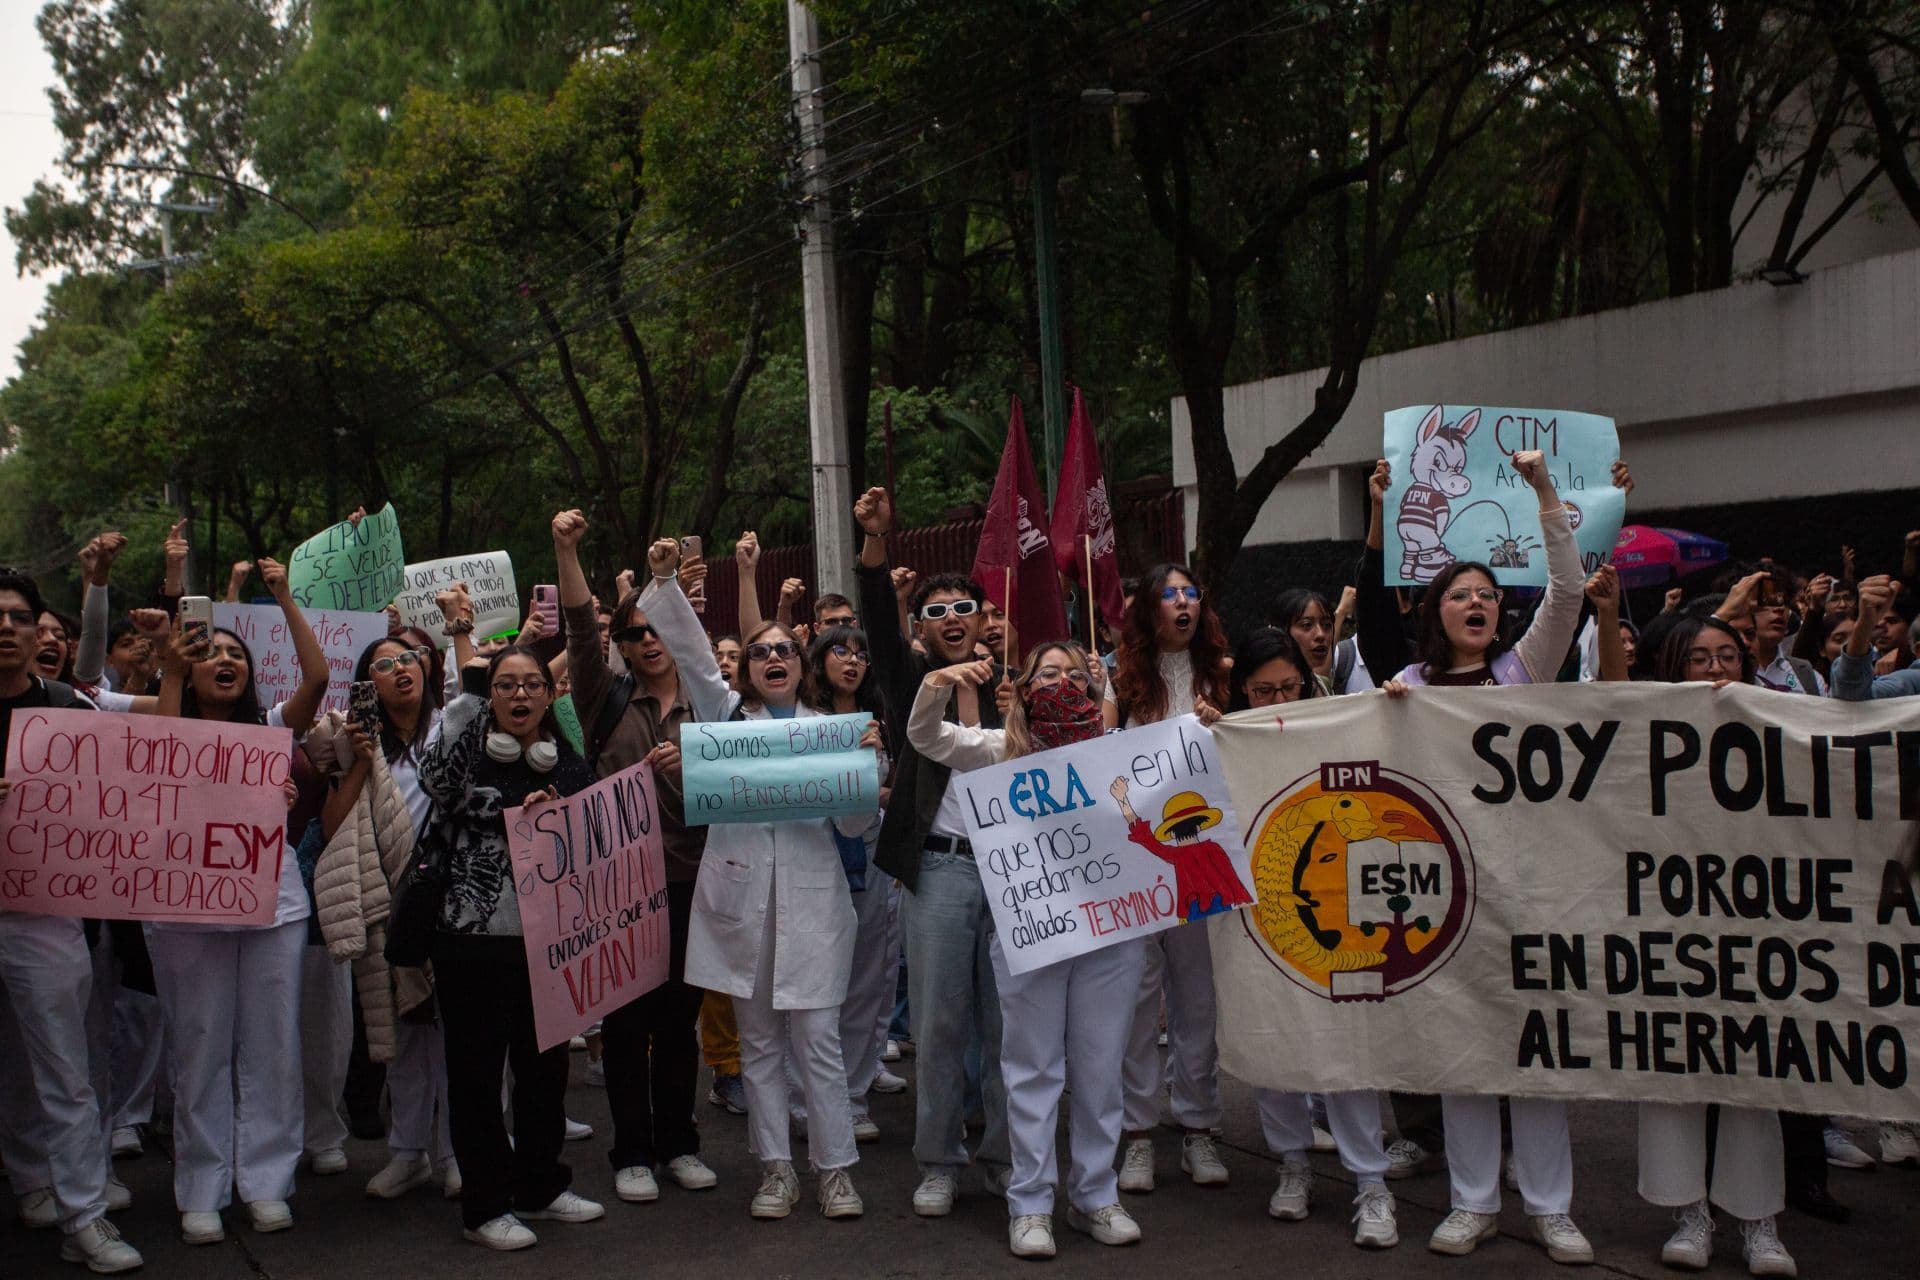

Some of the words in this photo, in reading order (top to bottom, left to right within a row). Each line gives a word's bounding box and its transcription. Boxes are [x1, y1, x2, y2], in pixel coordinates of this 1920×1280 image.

[1495, 415, 1558, 457] CTM
[1406, 490, 1432, 505] IPN
[1568, 461, 1585, 491] la
[294, 542, 315, 562] EL
[322, 518, 370, 555] IPN
[312, 557, 338, 581] SE
[415, 567, 441, 589] QUE
[442, 565, 459, 582] SE
[460, 558, 497, 579] AMA
[473, 576, 505, 594] CUIDA
[235, 615, 256, 641] Ni
[271, 619, 287, 642] el
[311, 613, 354, 647] strés
[408, 614, 418, 626] Y
[255, 668, 287, 686] duele
[328, 680, 352, 690] com
[262, 650, 280, 667] de
[19, 714, 100, 776] Con
[119, 725, 191, 779] tanto
[195, 734, 291, 787] dinero
[699, 723, 772, 762] Somos
[784, 717, 865, 754] BURROS
[966, 787, 1008, 830] La
[1008, 762, 1097, 822] ERA
[1130, 747, 1178, 789] en
[1178, 725, 1209, 776] la
[1327, 766, 1372, 789] IPN
[1470, 720, 1622, 805] SOY
[98, 780, 129, 822] la
[138, 782, 188, 825] 4T
[696, 790, 723, 811] no
[534, 804, 575, 884] SI
[581, 790, 613, 867] NO
[613, 771, 652, 849] NOS
[165, 829, 193, 865] la
[202, 821, 285, 883] ESM
[988, 841, 1035, 884] que
[1034, 822, 1091, 866] nos
[48, 872, 98, 900] cae
[1001, 852, 1122, 923] quedamos
[1360, 862, 1442, 896] ESM
[1625, 850, 1854, 923] PORQUE
[1876, 859, 1920, 926] A
[547, 915, 613, 970] ENTONCES
[617, 900, 644, 930] QUE
[647, 887, 669, 915] NOS
[1011, 904, 1078, 950] callados
[1078, 874, 1176, 938] TERMINÓ
[1510, 933, 1588, 992] EN
[1603, 931, 1840, 1004] DESEOS
[1517, 1008, 1592, 1070] AL
[1606, 1009, 1908, 1091] HERMANO
